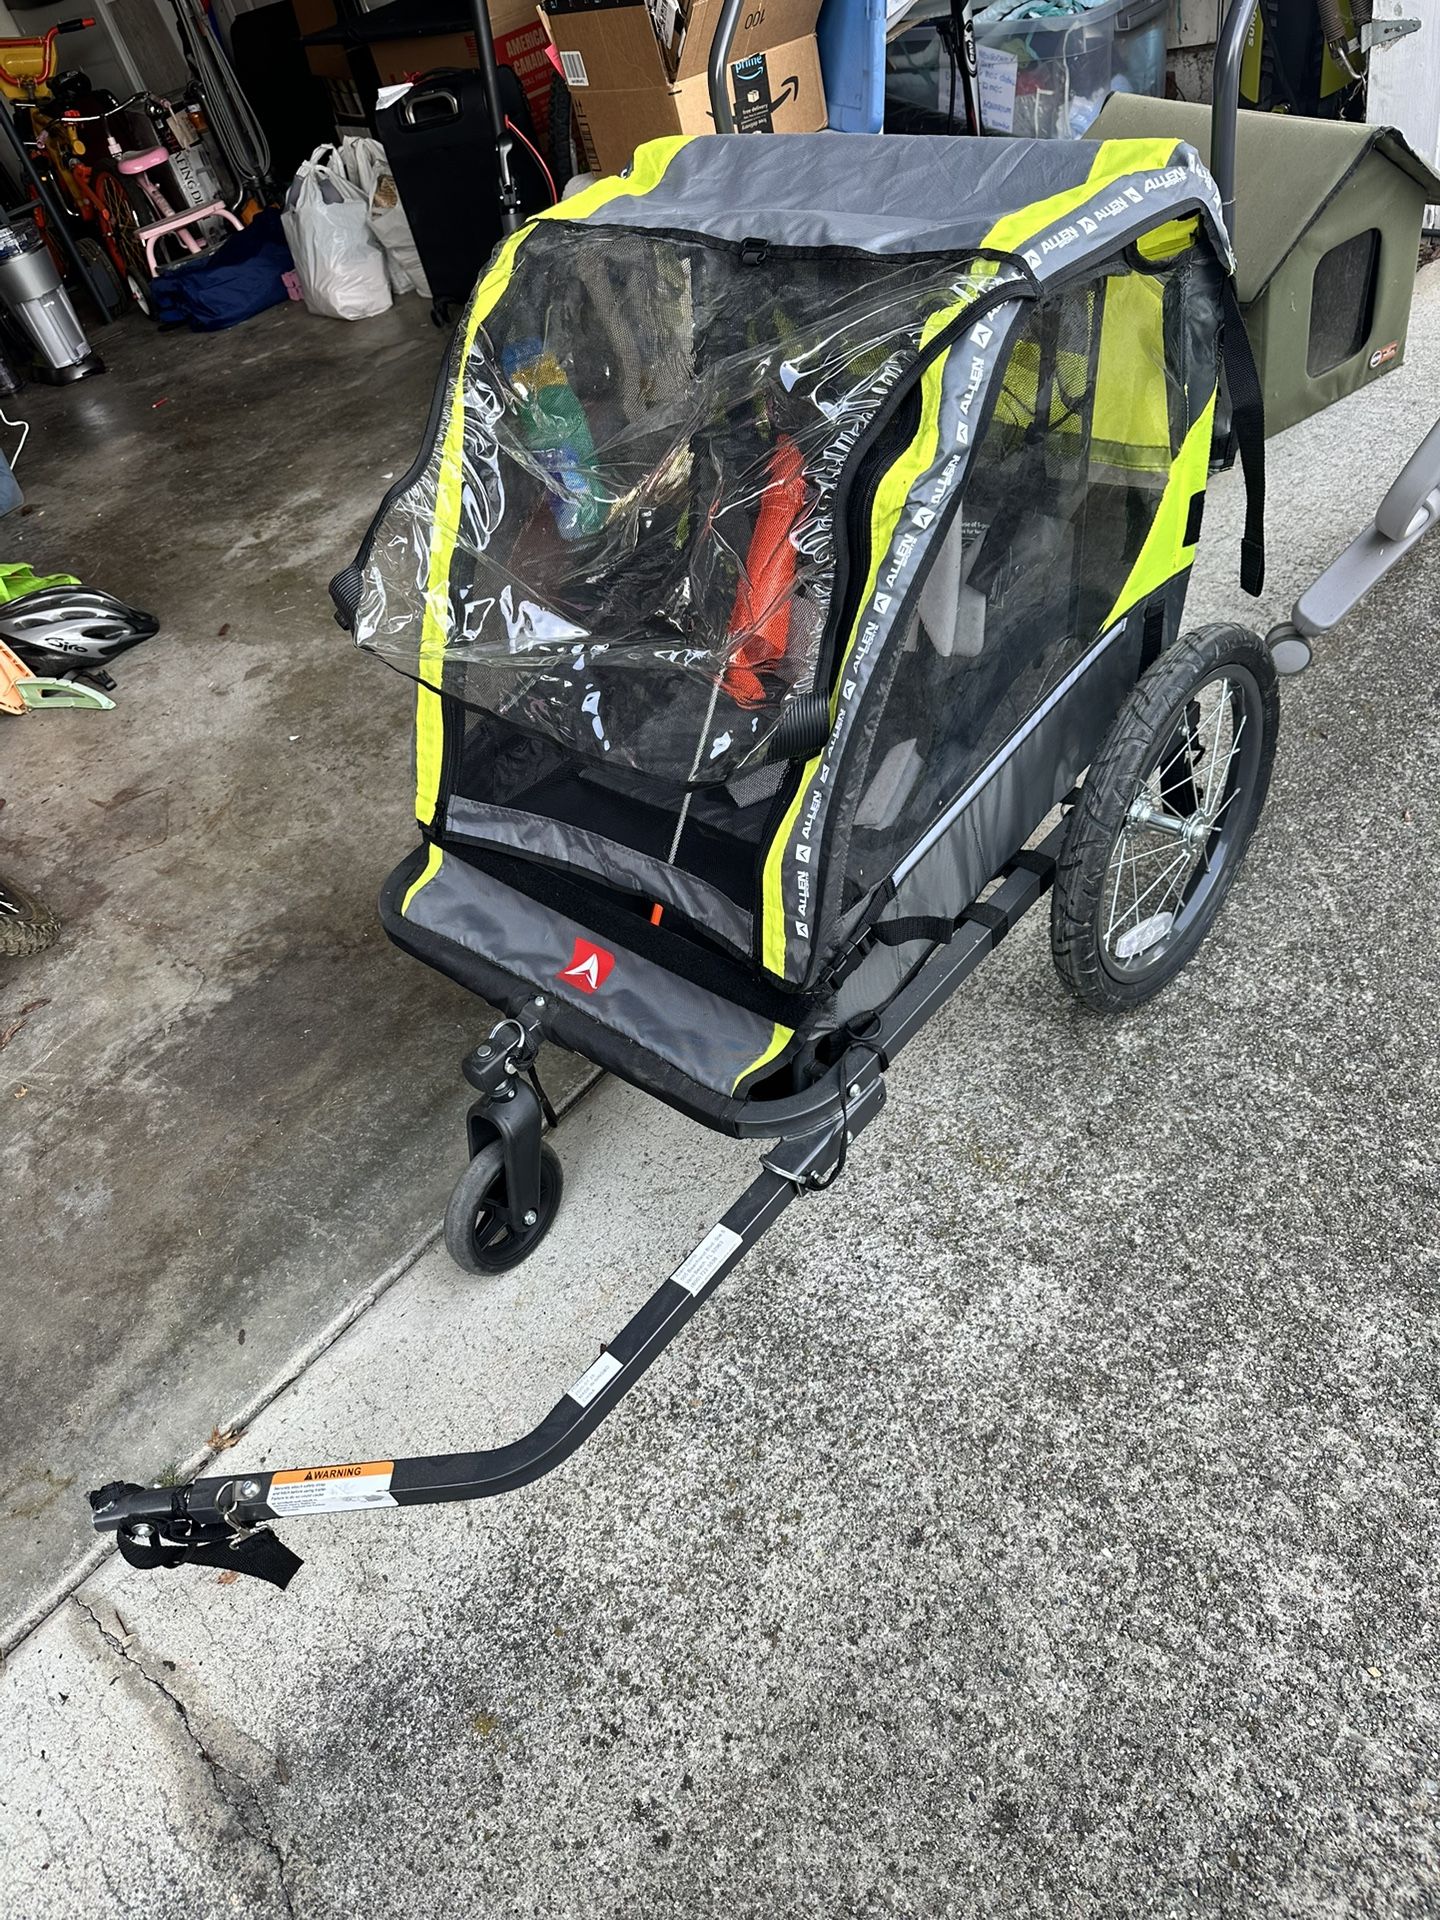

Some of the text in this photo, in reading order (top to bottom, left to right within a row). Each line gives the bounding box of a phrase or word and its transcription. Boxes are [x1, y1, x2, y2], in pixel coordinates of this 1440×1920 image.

[744, 9, 766, 30] 100
[506, 27, 546, 58] AMERICA
[512, 48, 550, 76] CANADA
[736, 56, 762, 73] prime
[1144, 166, 1186, 192] ALLEN
[1094, 196, 1126, 222] ALLEN
[1040, 226, 1076, 254] ALLEN
[959, 356, 985, 415] ALLEN
[930, 454, 962, 504] ALLEN
[886, 534, 914, 588] ALLEN
[45, 637, 88, 652] Giro
[852, 621, 878, 674] ALLEN
[828, 708, 846, 759] ALLEN
[801, 790, 822, 840] ALLEN
[796, 871, 807, 917] ALLEN
[314, 1467, 362, 1480] WARNING
